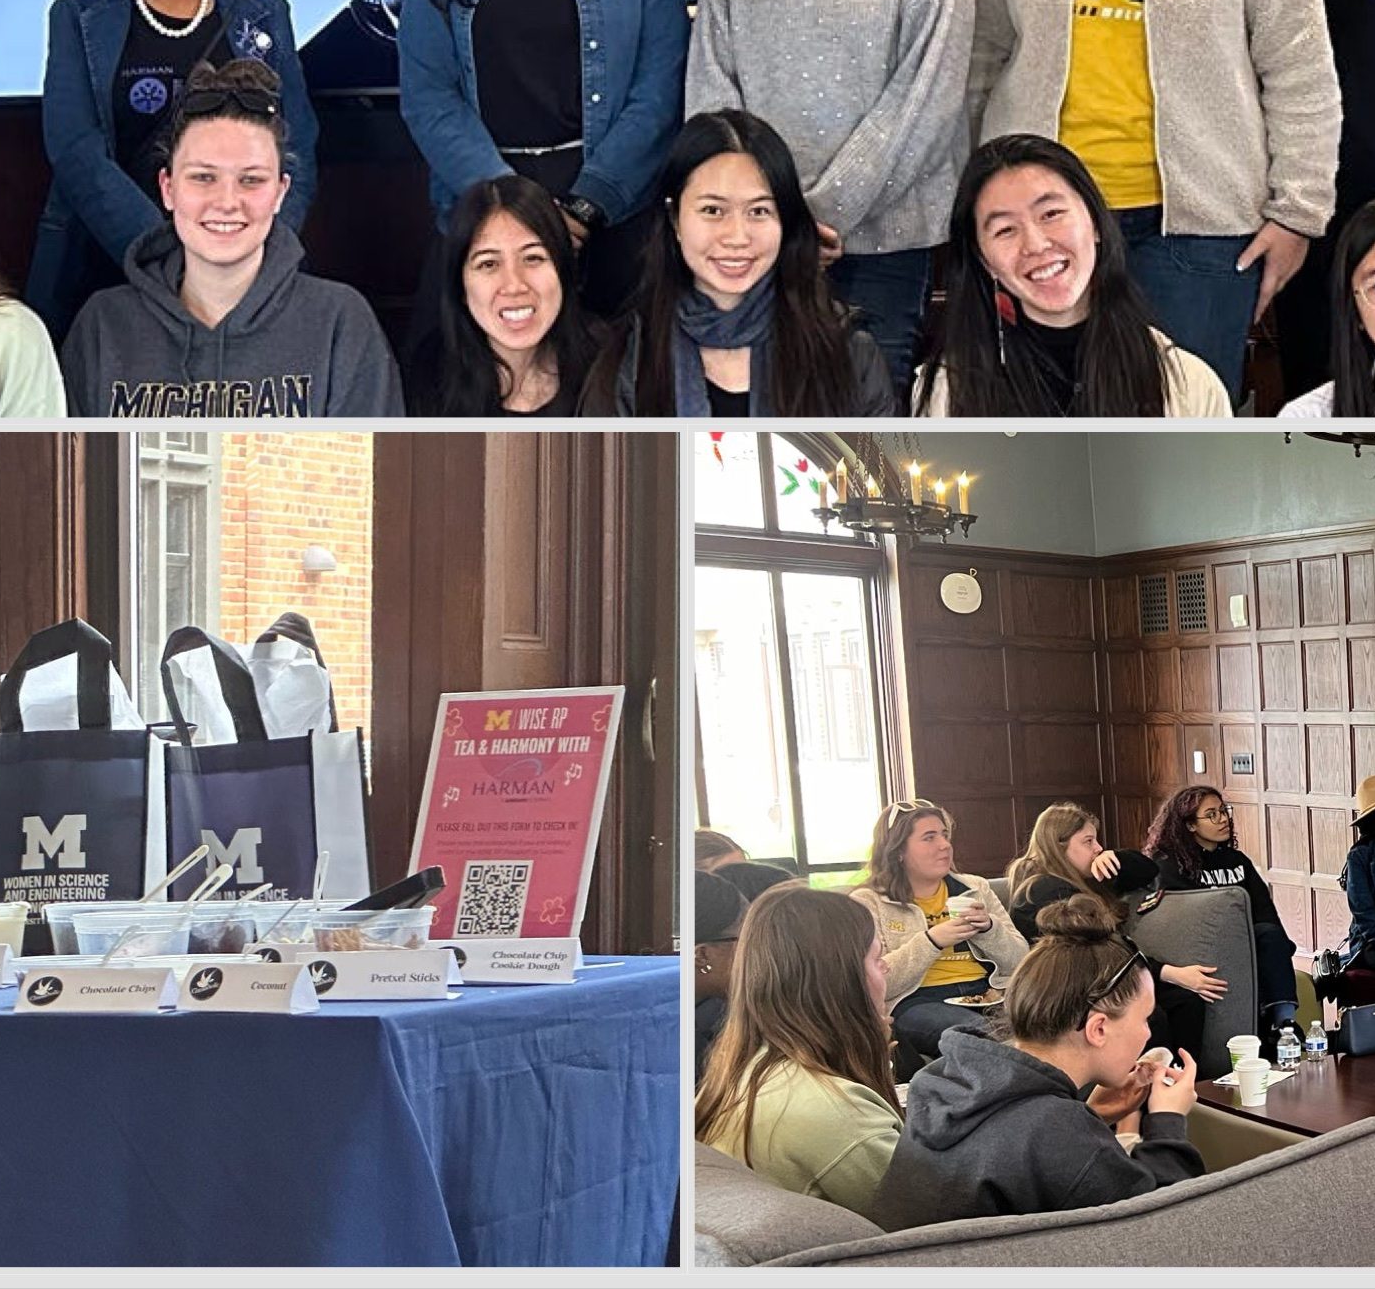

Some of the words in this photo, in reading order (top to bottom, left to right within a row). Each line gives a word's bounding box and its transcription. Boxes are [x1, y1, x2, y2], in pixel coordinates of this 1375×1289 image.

[110, 375, 312, 418] MICHIGAN
[484, 709, 513, 731] M
[517, 708, 549, 730] WISE
[551, 707, 568, 730] RP
[454, 740, 474, 756] TEA
[478, 739, 488, 756] &
[491, 737, 555, 755] HARMONY
[557, 736, 591, 753] WITH
[472, 780, 556, 796] HARMAN
[21, 814, 86, 870] M
[201, 827, 264, 884] M
[3, 875, 42, 889] WOMEN
[44, 875, 56, 887] IN
[59, 874, 109, 887] SCIENCE
[4, 889, 26, 902] AND
[28, 887, 106, 902] ENGINEERING
[224, 890, 236, 901] IN
[492, 950, 542, 960] Chocolate
[543, 950, 568, 961] Chip
[490, 961, 525, 970] Cookie
[527, 962, 561, 971] Dough
[408, 972, 441, 983] Sticks
[80, 985, 126, 994] Chocolate
[128, 984, 156, 994] Chips
[250, 981, 288, 991] Coconut
